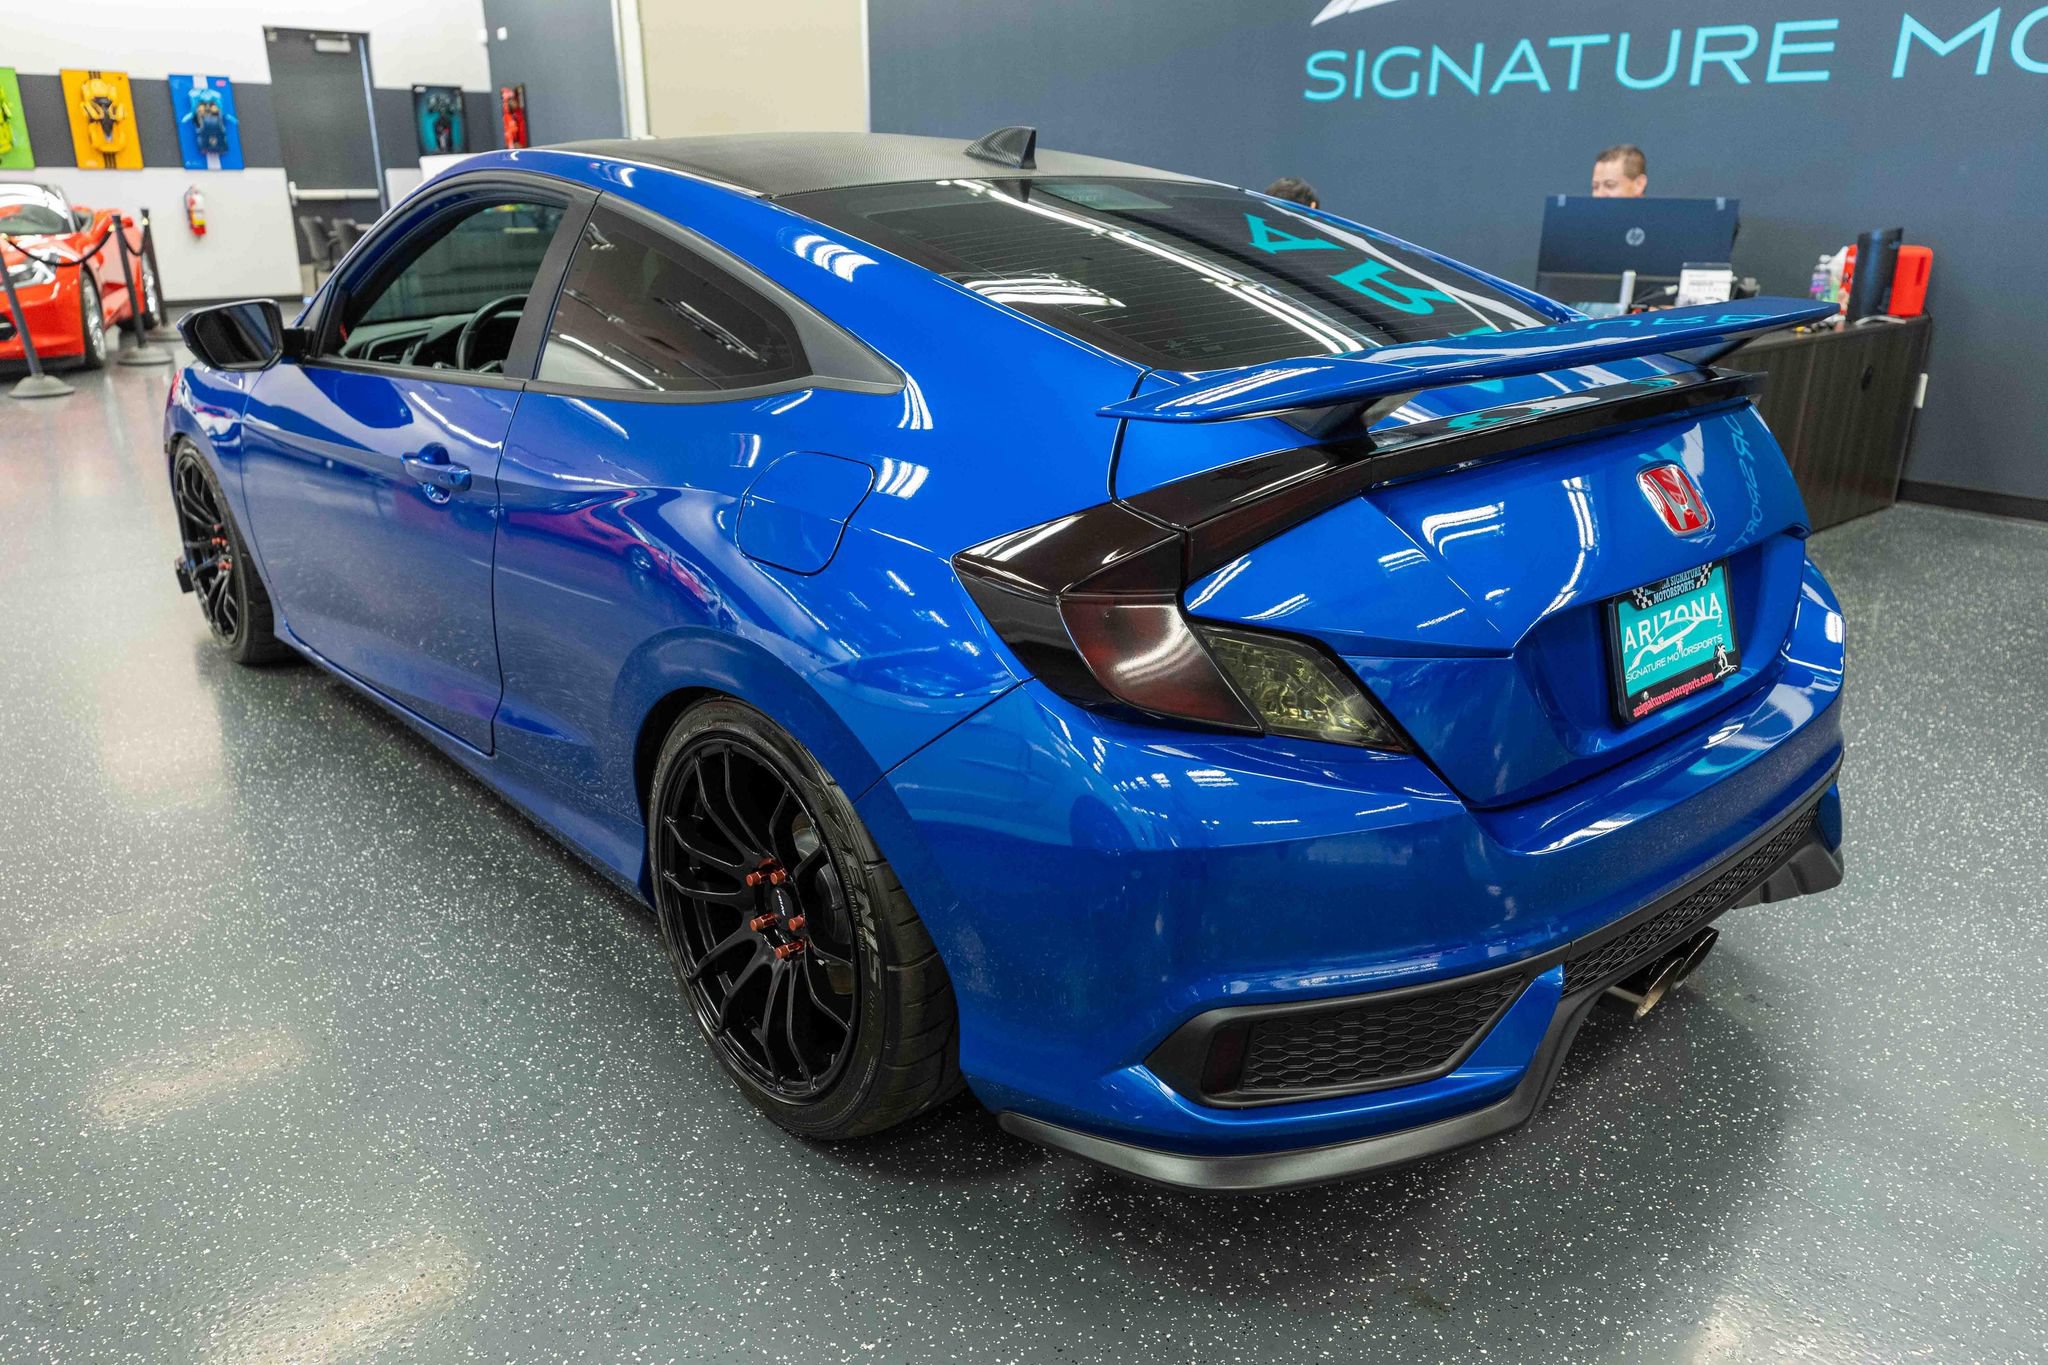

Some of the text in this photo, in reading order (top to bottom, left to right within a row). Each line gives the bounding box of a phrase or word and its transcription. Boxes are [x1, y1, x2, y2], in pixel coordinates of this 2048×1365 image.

[1303, 18, 1840, 101] SIGNATURE
[1670, 566, 1702, 585] SIGNATURE
[1653, 579, 1695, 604] MOTORSPORTS
[1624, 592, 1722, 653] ARIZONA
[1626, 657, 1666, 683] SIGNATURE
